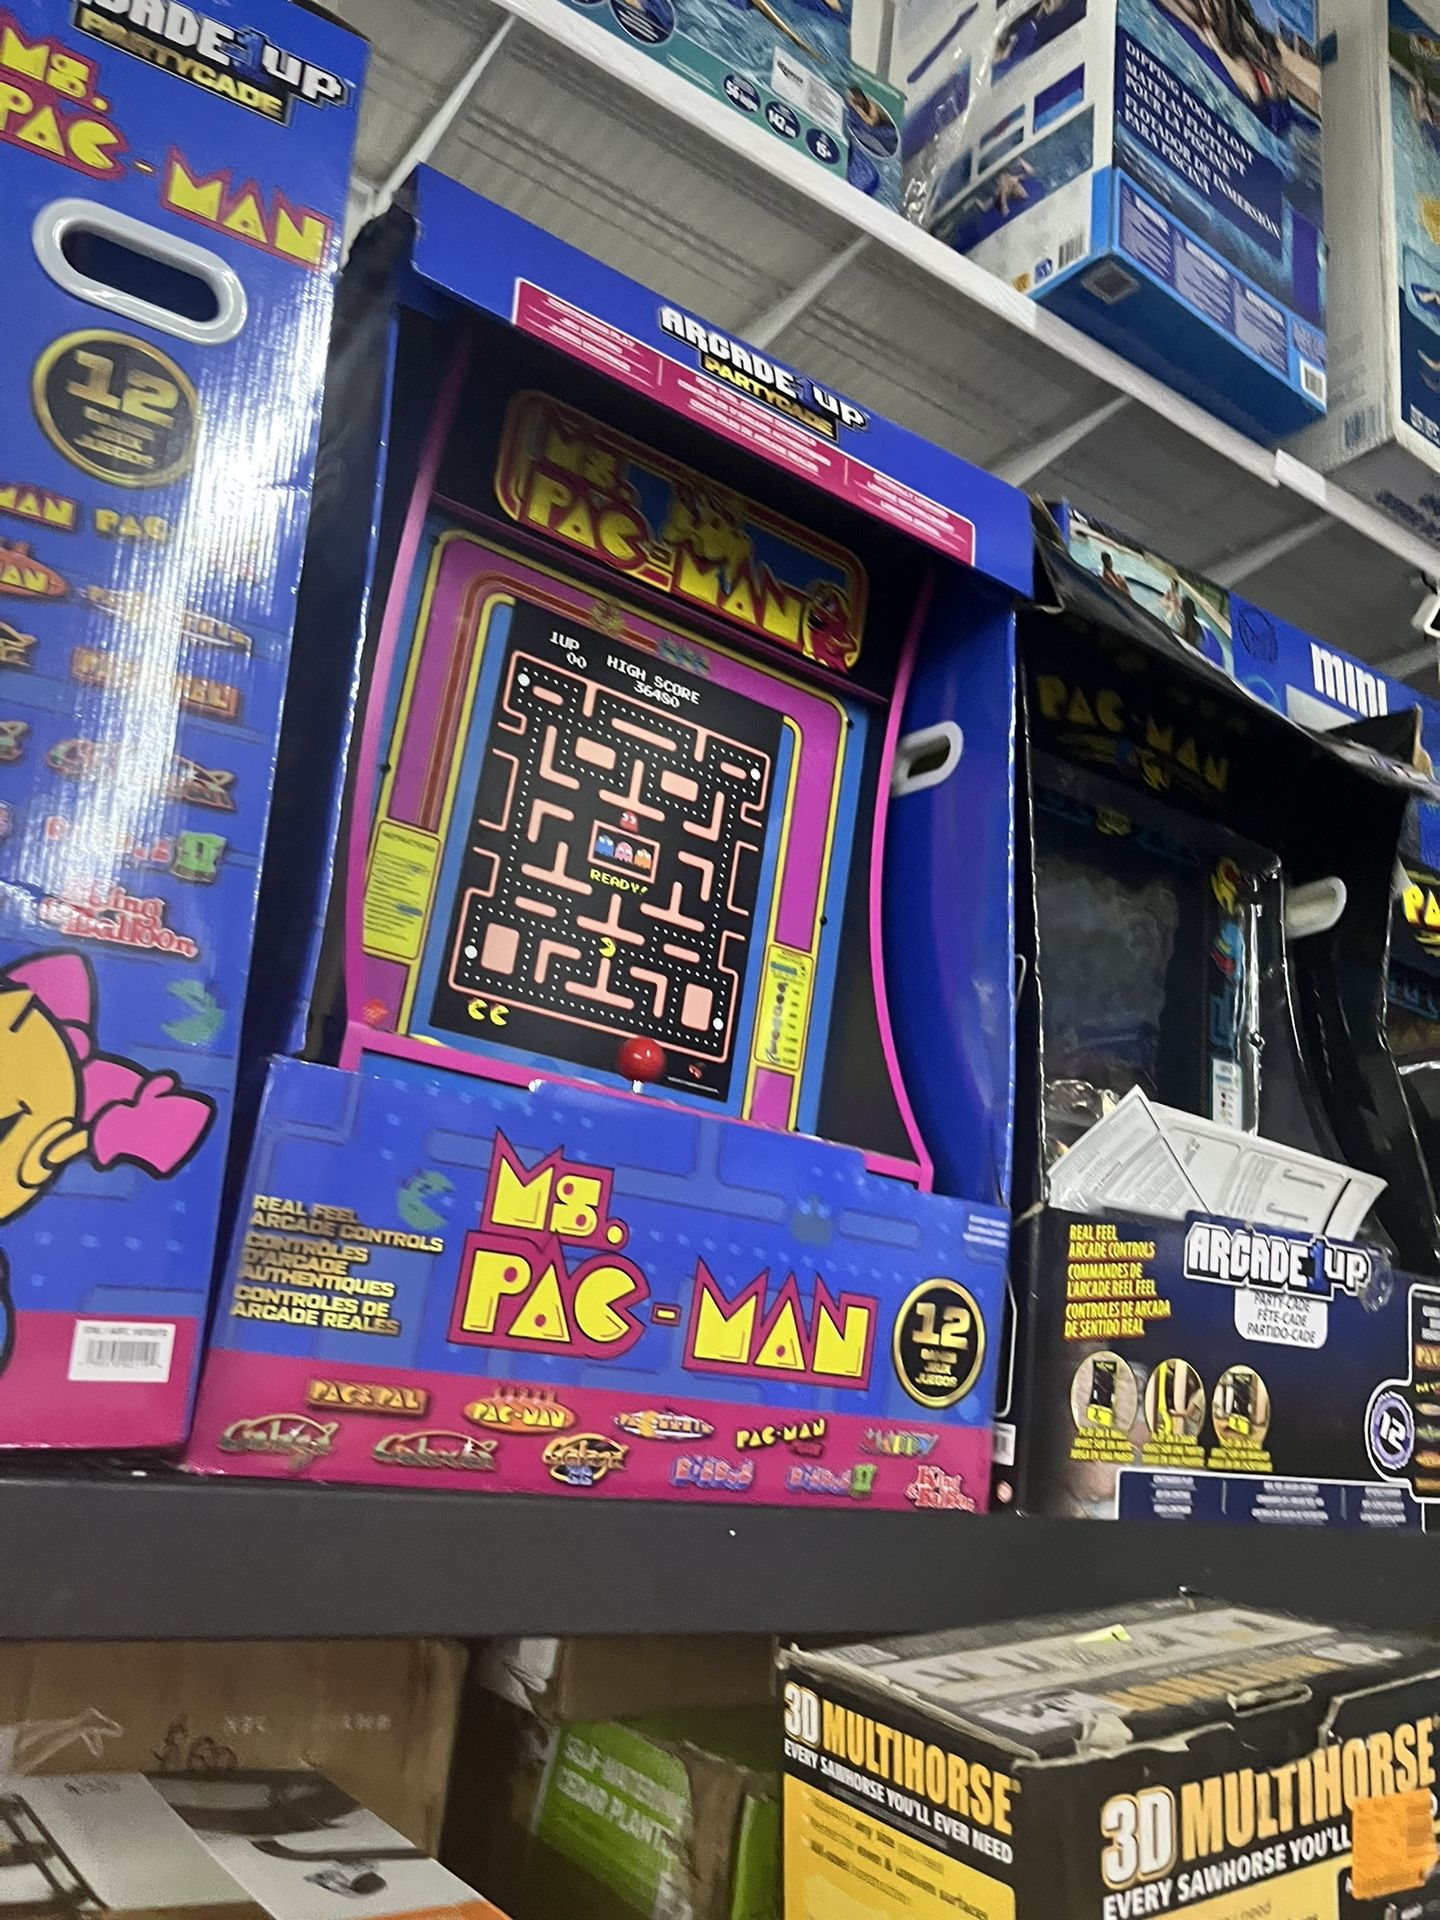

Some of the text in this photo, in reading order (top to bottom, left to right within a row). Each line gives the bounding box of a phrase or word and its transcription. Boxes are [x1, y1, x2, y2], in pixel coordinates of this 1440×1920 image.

[81, 8, 284, 119] PARTYCADE
[1125, 39, 1255, 166] DIPPING POOL FLOAT
[1125, 58, 1247, 177] MATELAS FLOTTANT
[1125, 73, 1231, 179] POUR LA PISCINE
[1125, 92, 1193, 164] FLOTADOR
[1193, 155, 1212, 181] DE
[1125, 108, 1211, 195] PARA PISCINA
[67, 349, 179, 429] 12
[703, 356, 834, 438] PARTYCADE
[550, 631, 581, 650] 1UP
[566, 652, 588, 670] 00
[606, 654, 700, 705] HIGH SCORE
[589, 868, 649, 894] READY!
[253, 1194, 360, 1224] REAL FEEL
[251, 1211, 445, 1253] ARCADE CONTROLS
[1069, 1223, 1118, 1241] REAL FEEL
[242, 1248, 350, 1276] D'ARCADE
[1068, 1240, 1157, 1260] ARCADE CONTROLS
[239, 1264, 396, 1299] AUTHENTIQUES
[1066, 1280, 1111, 1299] L'ARCADE
[1134, 1278, 1158, 1297] FEEL
[1067, 1262, 1144, 1281] COMMANDES DE
[233, 1283, 391, 1318] CONTROLES DE
[461, 1248, 870, 1379] PAC-MAN
[1065, 1298, 1172, 1321] CONTROLES DE ARCADA
[1254, 1291, 1311, 1315] PARTY-CADE
[230, 1301, 402, 1336] ARCADE REALES
[911, 1302, 972, 1350] 12
[1064, 1318, 1146, 1340] DE SENTIDO REAL
[1246, 1321, 1317, 1345] PARTIDO-CADE
[734, 1418, 826, 1450] PAC-MAN
[784, 1681, 821, 1748] 3D
[822, 1699, 1013, 1836] MULTIHORSE
[784, 1737, 819, 1770] EVERY
[819, 1756, 885, 1804] SAWHORSE
[886, 1787, 932, 1827] YOU'LL
[933, 1810, 970, 1847] EVER
[972, 1826, 1013, 1865] NEED
[1101, 1716, 1437, 1886] 3D MULTIHORSE
[1102, 1823, 1352, 1920] EVERY SAWHORSE YOU'LL
